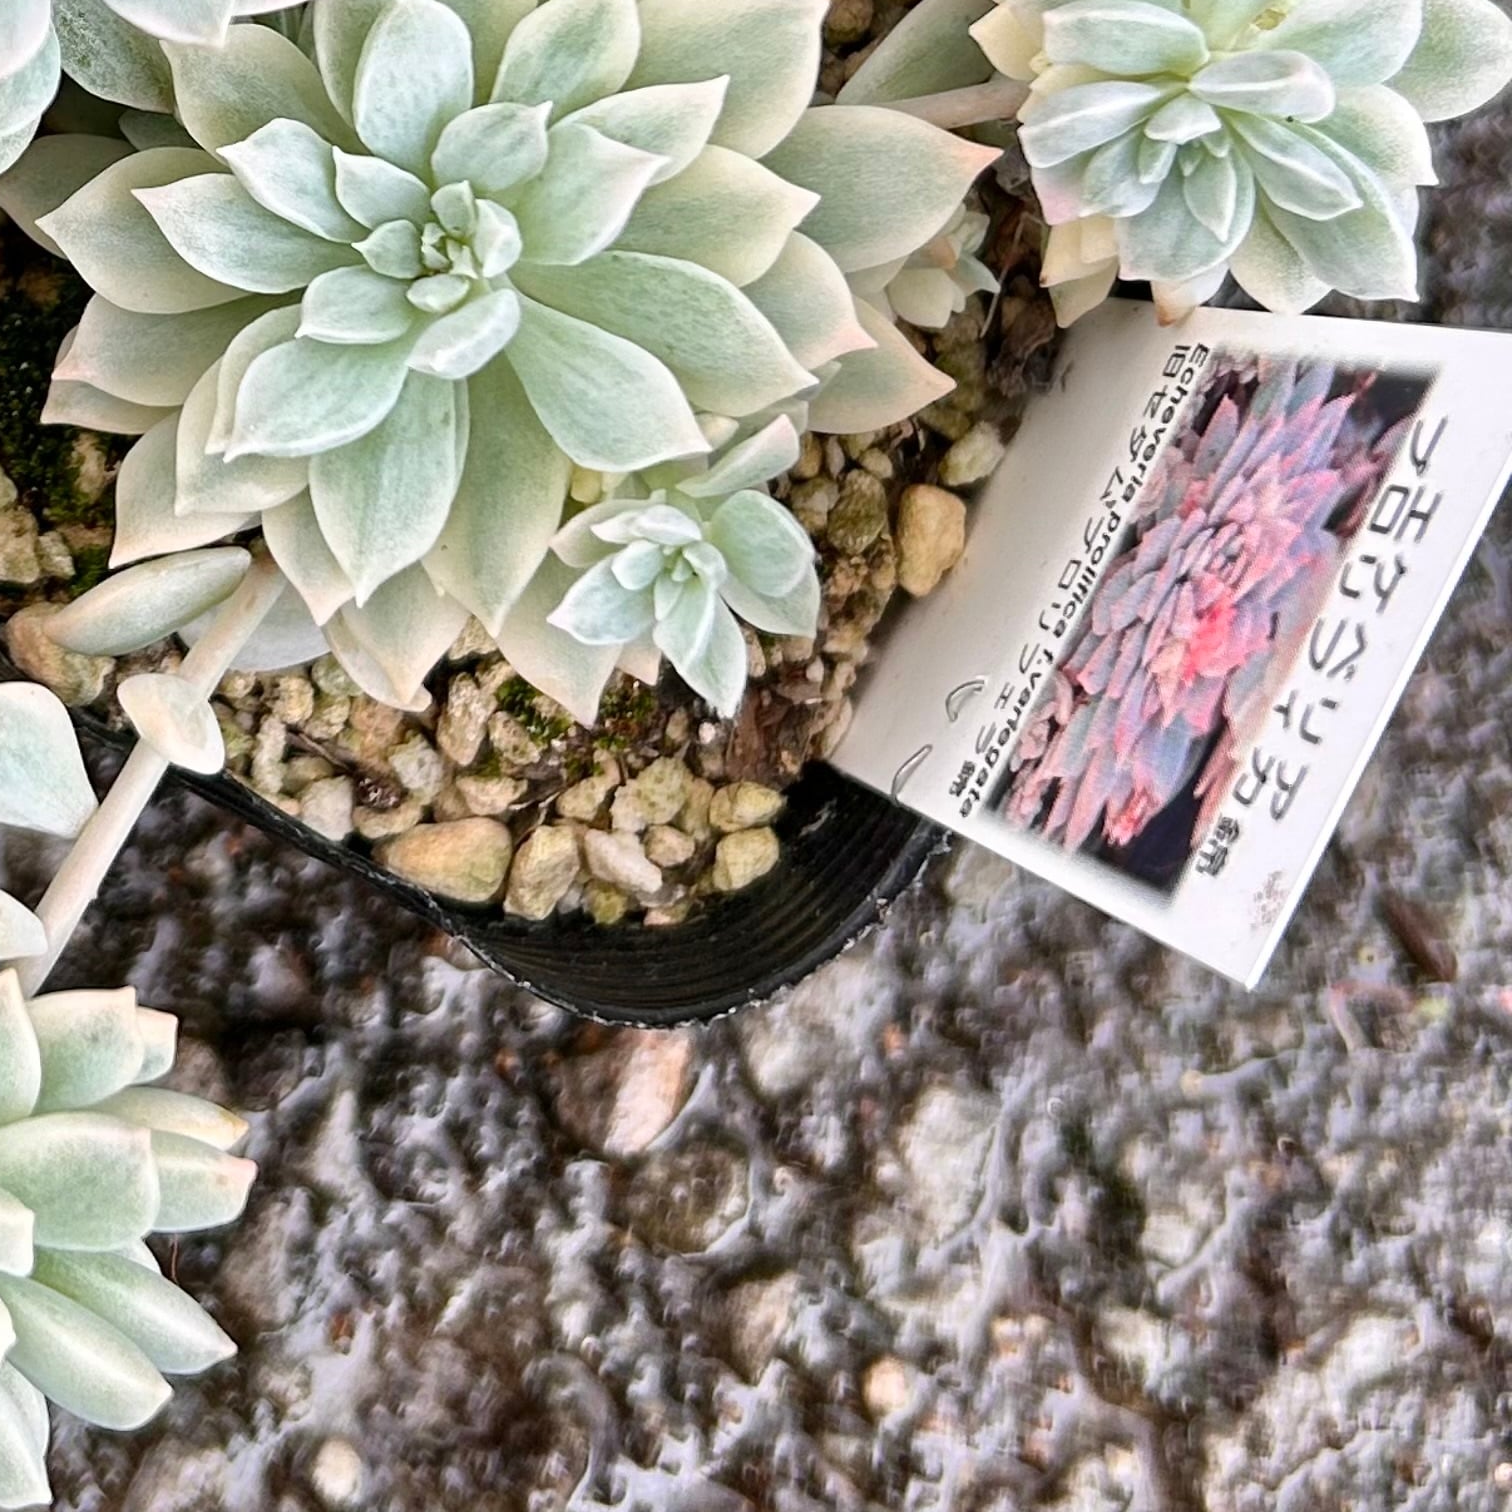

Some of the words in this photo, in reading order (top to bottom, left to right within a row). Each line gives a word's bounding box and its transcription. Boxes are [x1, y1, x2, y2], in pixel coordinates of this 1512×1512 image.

[1121, 342, 1209, 503] Echeveria
[1053, 510, 1121, 638] prolifica
[1269, 486, 1442, 821] エケベリア
